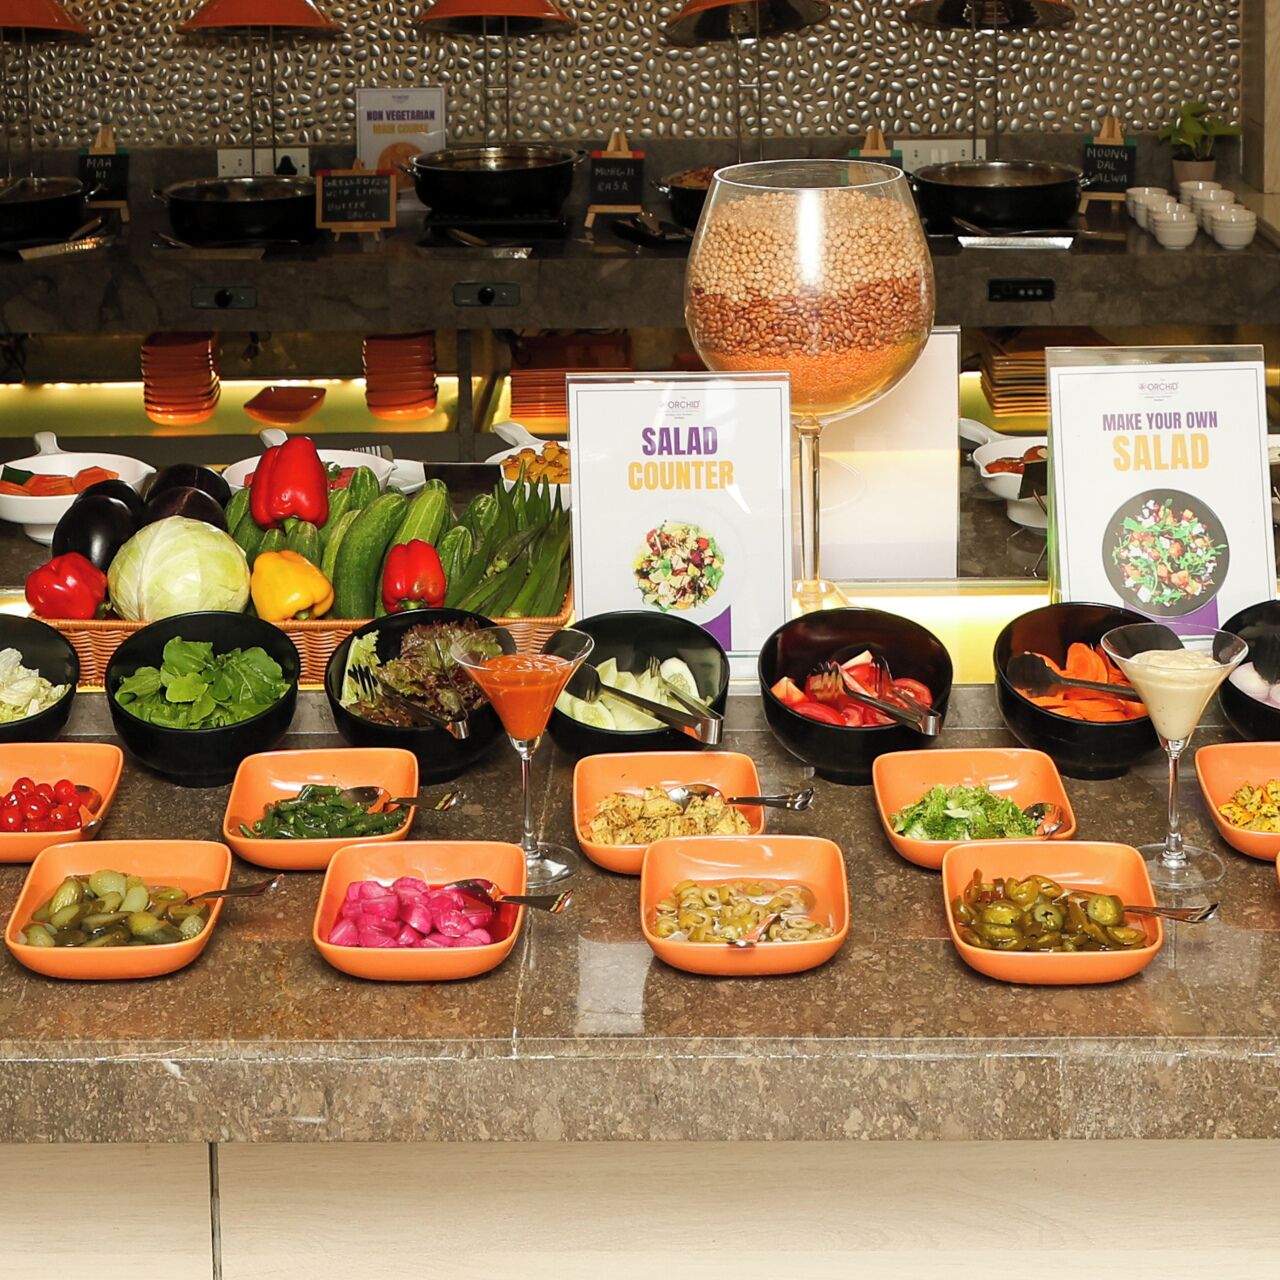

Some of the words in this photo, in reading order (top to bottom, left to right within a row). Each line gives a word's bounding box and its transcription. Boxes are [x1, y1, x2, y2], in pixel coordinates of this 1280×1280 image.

[367, 110, 384, 121] NON
[386, 110, 435, 121] VEGETARIAN
[1086, 147, 1128, 160] MOONG
[1097, 160, 1116, 171] DAL
[1147, 382, 1178, 392] ORCHID
[667, 400, 699, 409] ORCHID
[1102, 412, 1142, 432] MAKE
[1146, 411, 1182, 430] YOUR
[1186, 410, 1218, 429] OWN
[642, 426, 718, 456] SALAD
[1112, 432, 1210, 472] SALAD
[628, 460, 734, 491] COUNTER
